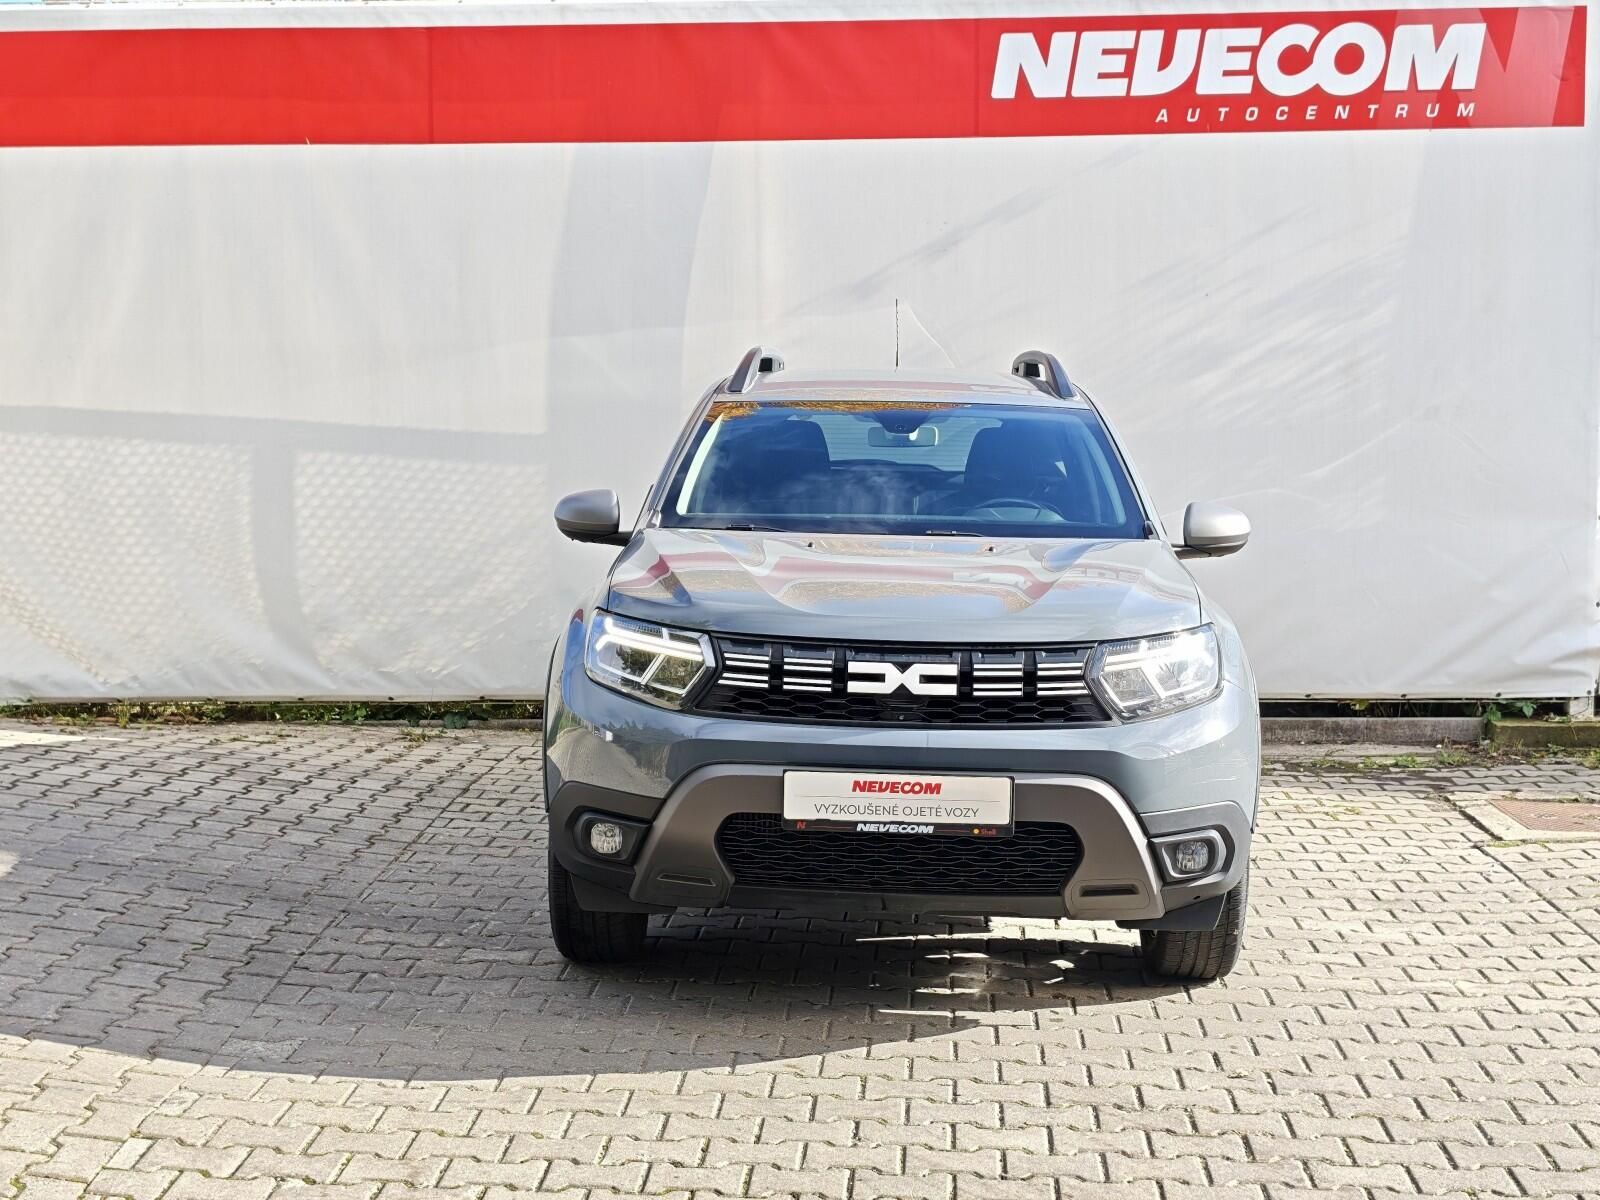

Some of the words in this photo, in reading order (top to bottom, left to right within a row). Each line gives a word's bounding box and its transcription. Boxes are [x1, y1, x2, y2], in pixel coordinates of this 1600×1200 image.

[991, 22, 1487, 98] NEVECOM
[1155, 102, 1476, 123] AUTOCENTRUM
[851, 780, 942, 795] NEVECOM
[814, 803, 899, 816] VYZKOUŠENÉ
[902, 804, 942, 818] OJETÉ
[944, 807, 980, 818] VOZY
[856, 823, 935, 834] NEVECOM
